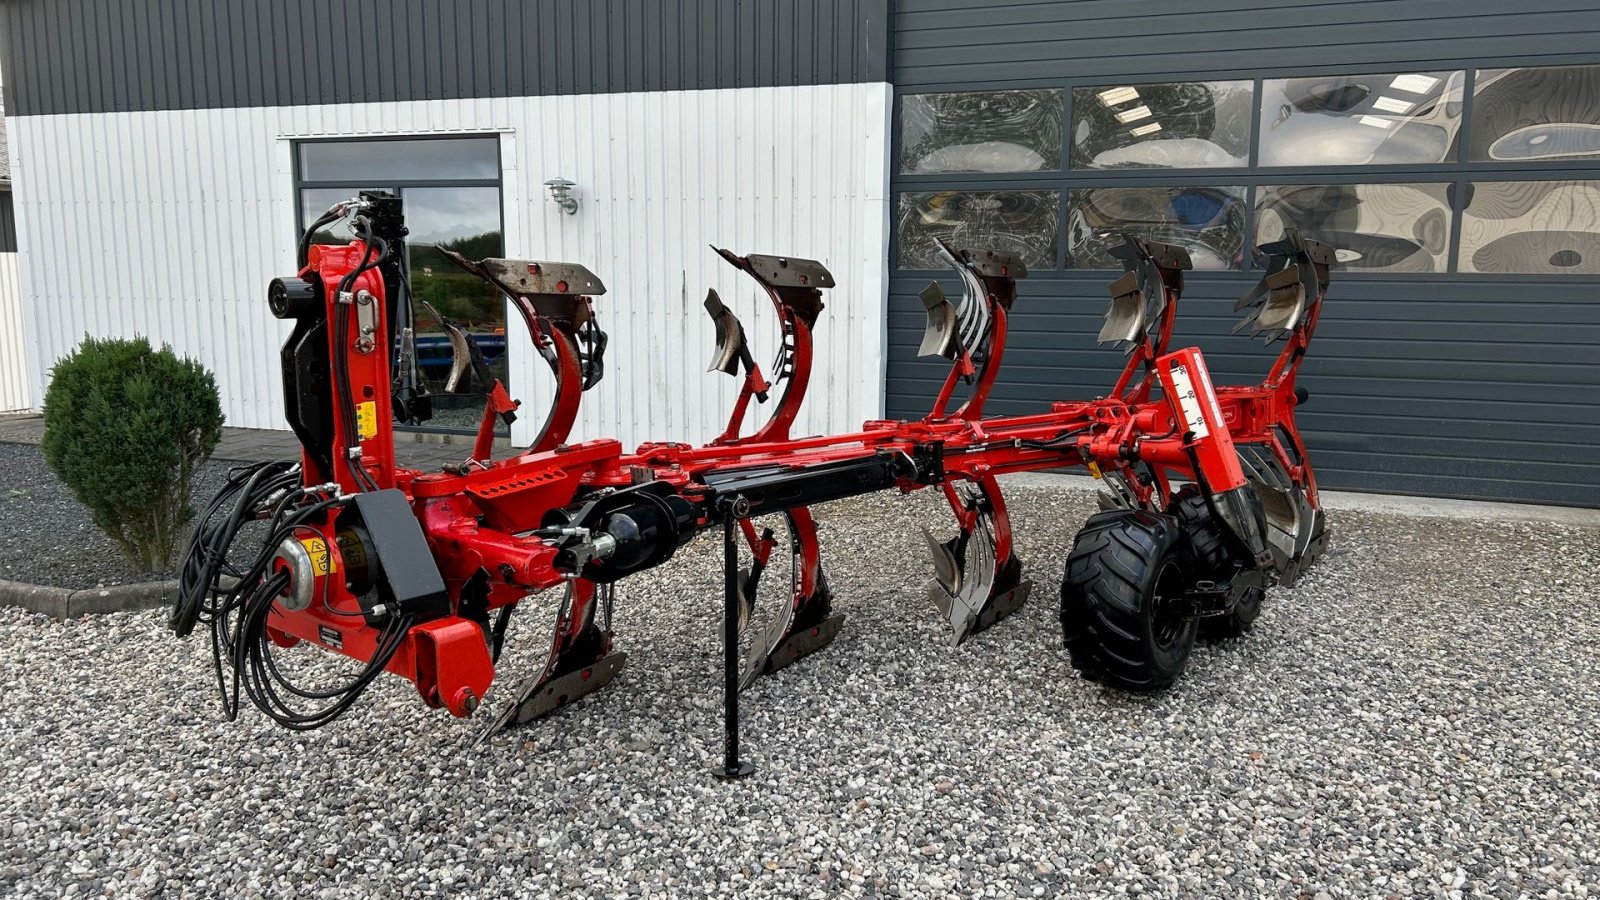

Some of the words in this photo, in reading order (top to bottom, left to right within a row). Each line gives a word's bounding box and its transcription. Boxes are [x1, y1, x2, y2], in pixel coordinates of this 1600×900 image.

[1179, 366, 1186, 375] 30
[1187, 390, 1195, 399] 20
[1196, 416, 1204, 425] 10
